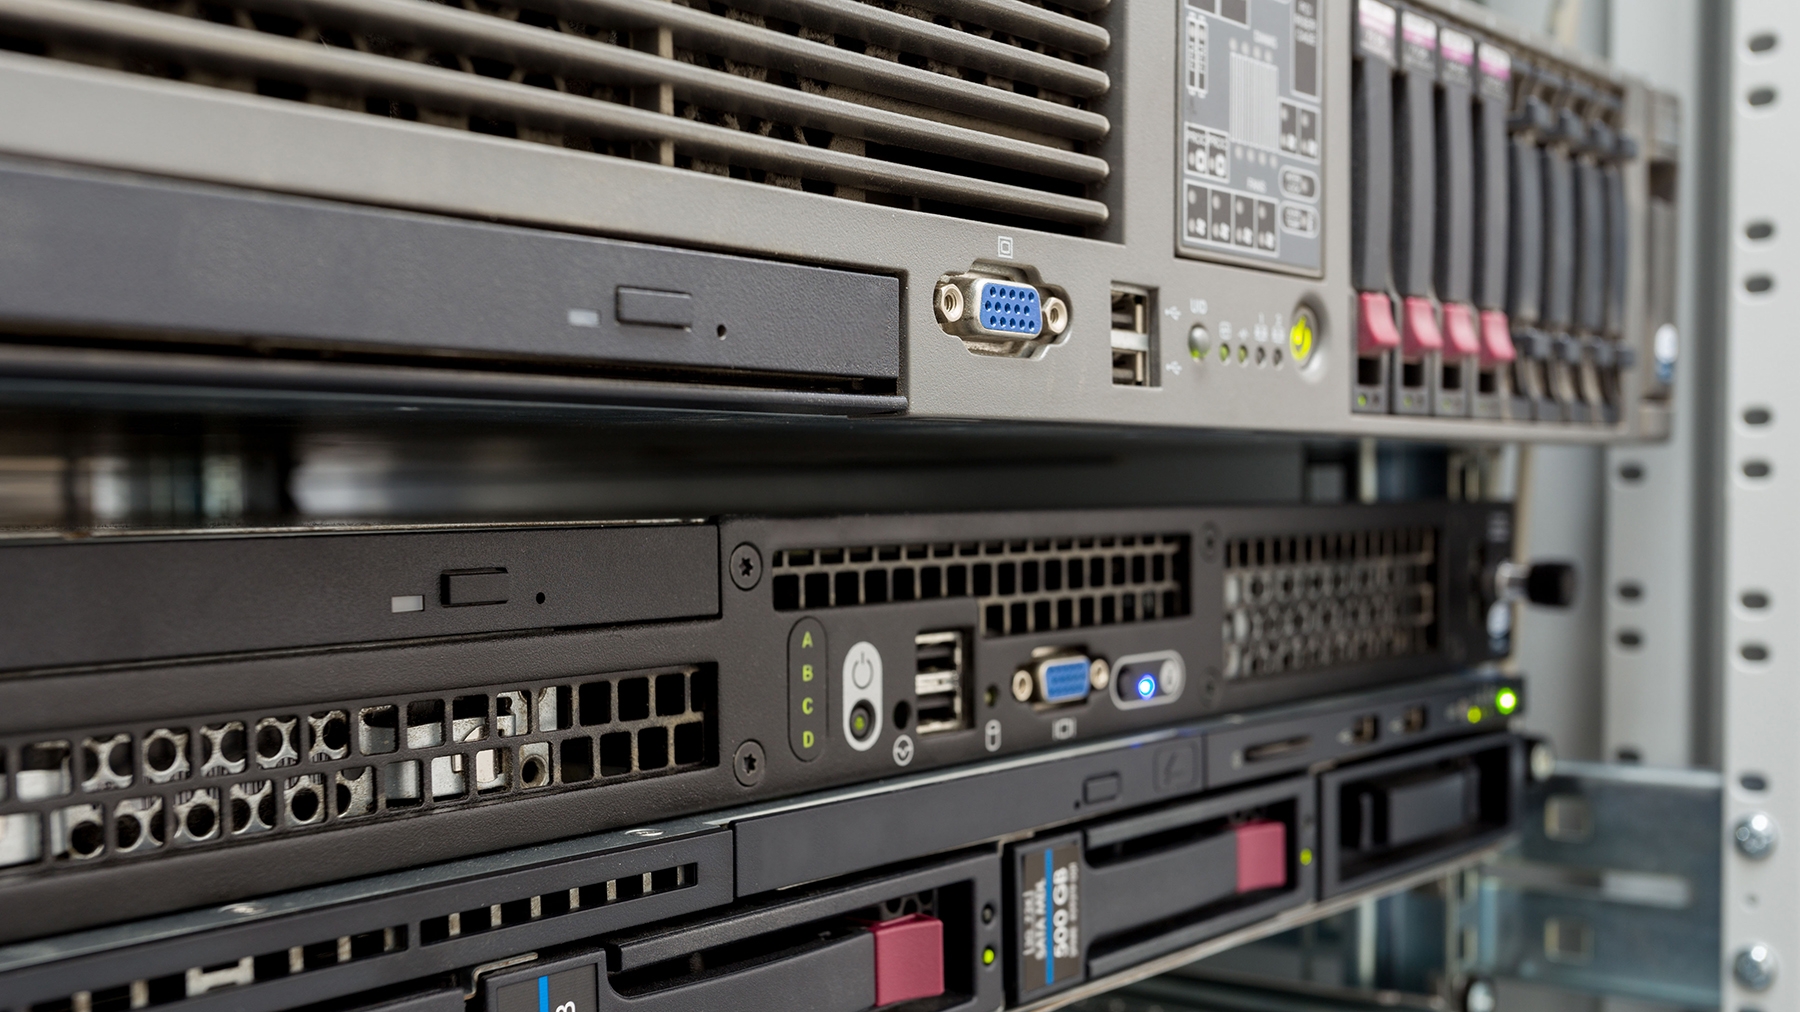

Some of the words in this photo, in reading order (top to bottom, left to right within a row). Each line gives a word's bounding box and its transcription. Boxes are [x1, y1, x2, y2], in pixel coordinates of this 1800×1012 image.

[802, 631, 813, 648] A
[802, 665, 813, 682] B
[802, 697, 813, 715] C
[803, 731, 814, 748] D
[1053, 867, 1069, 906] GB
[1053, 909, 1069, 958] 500
